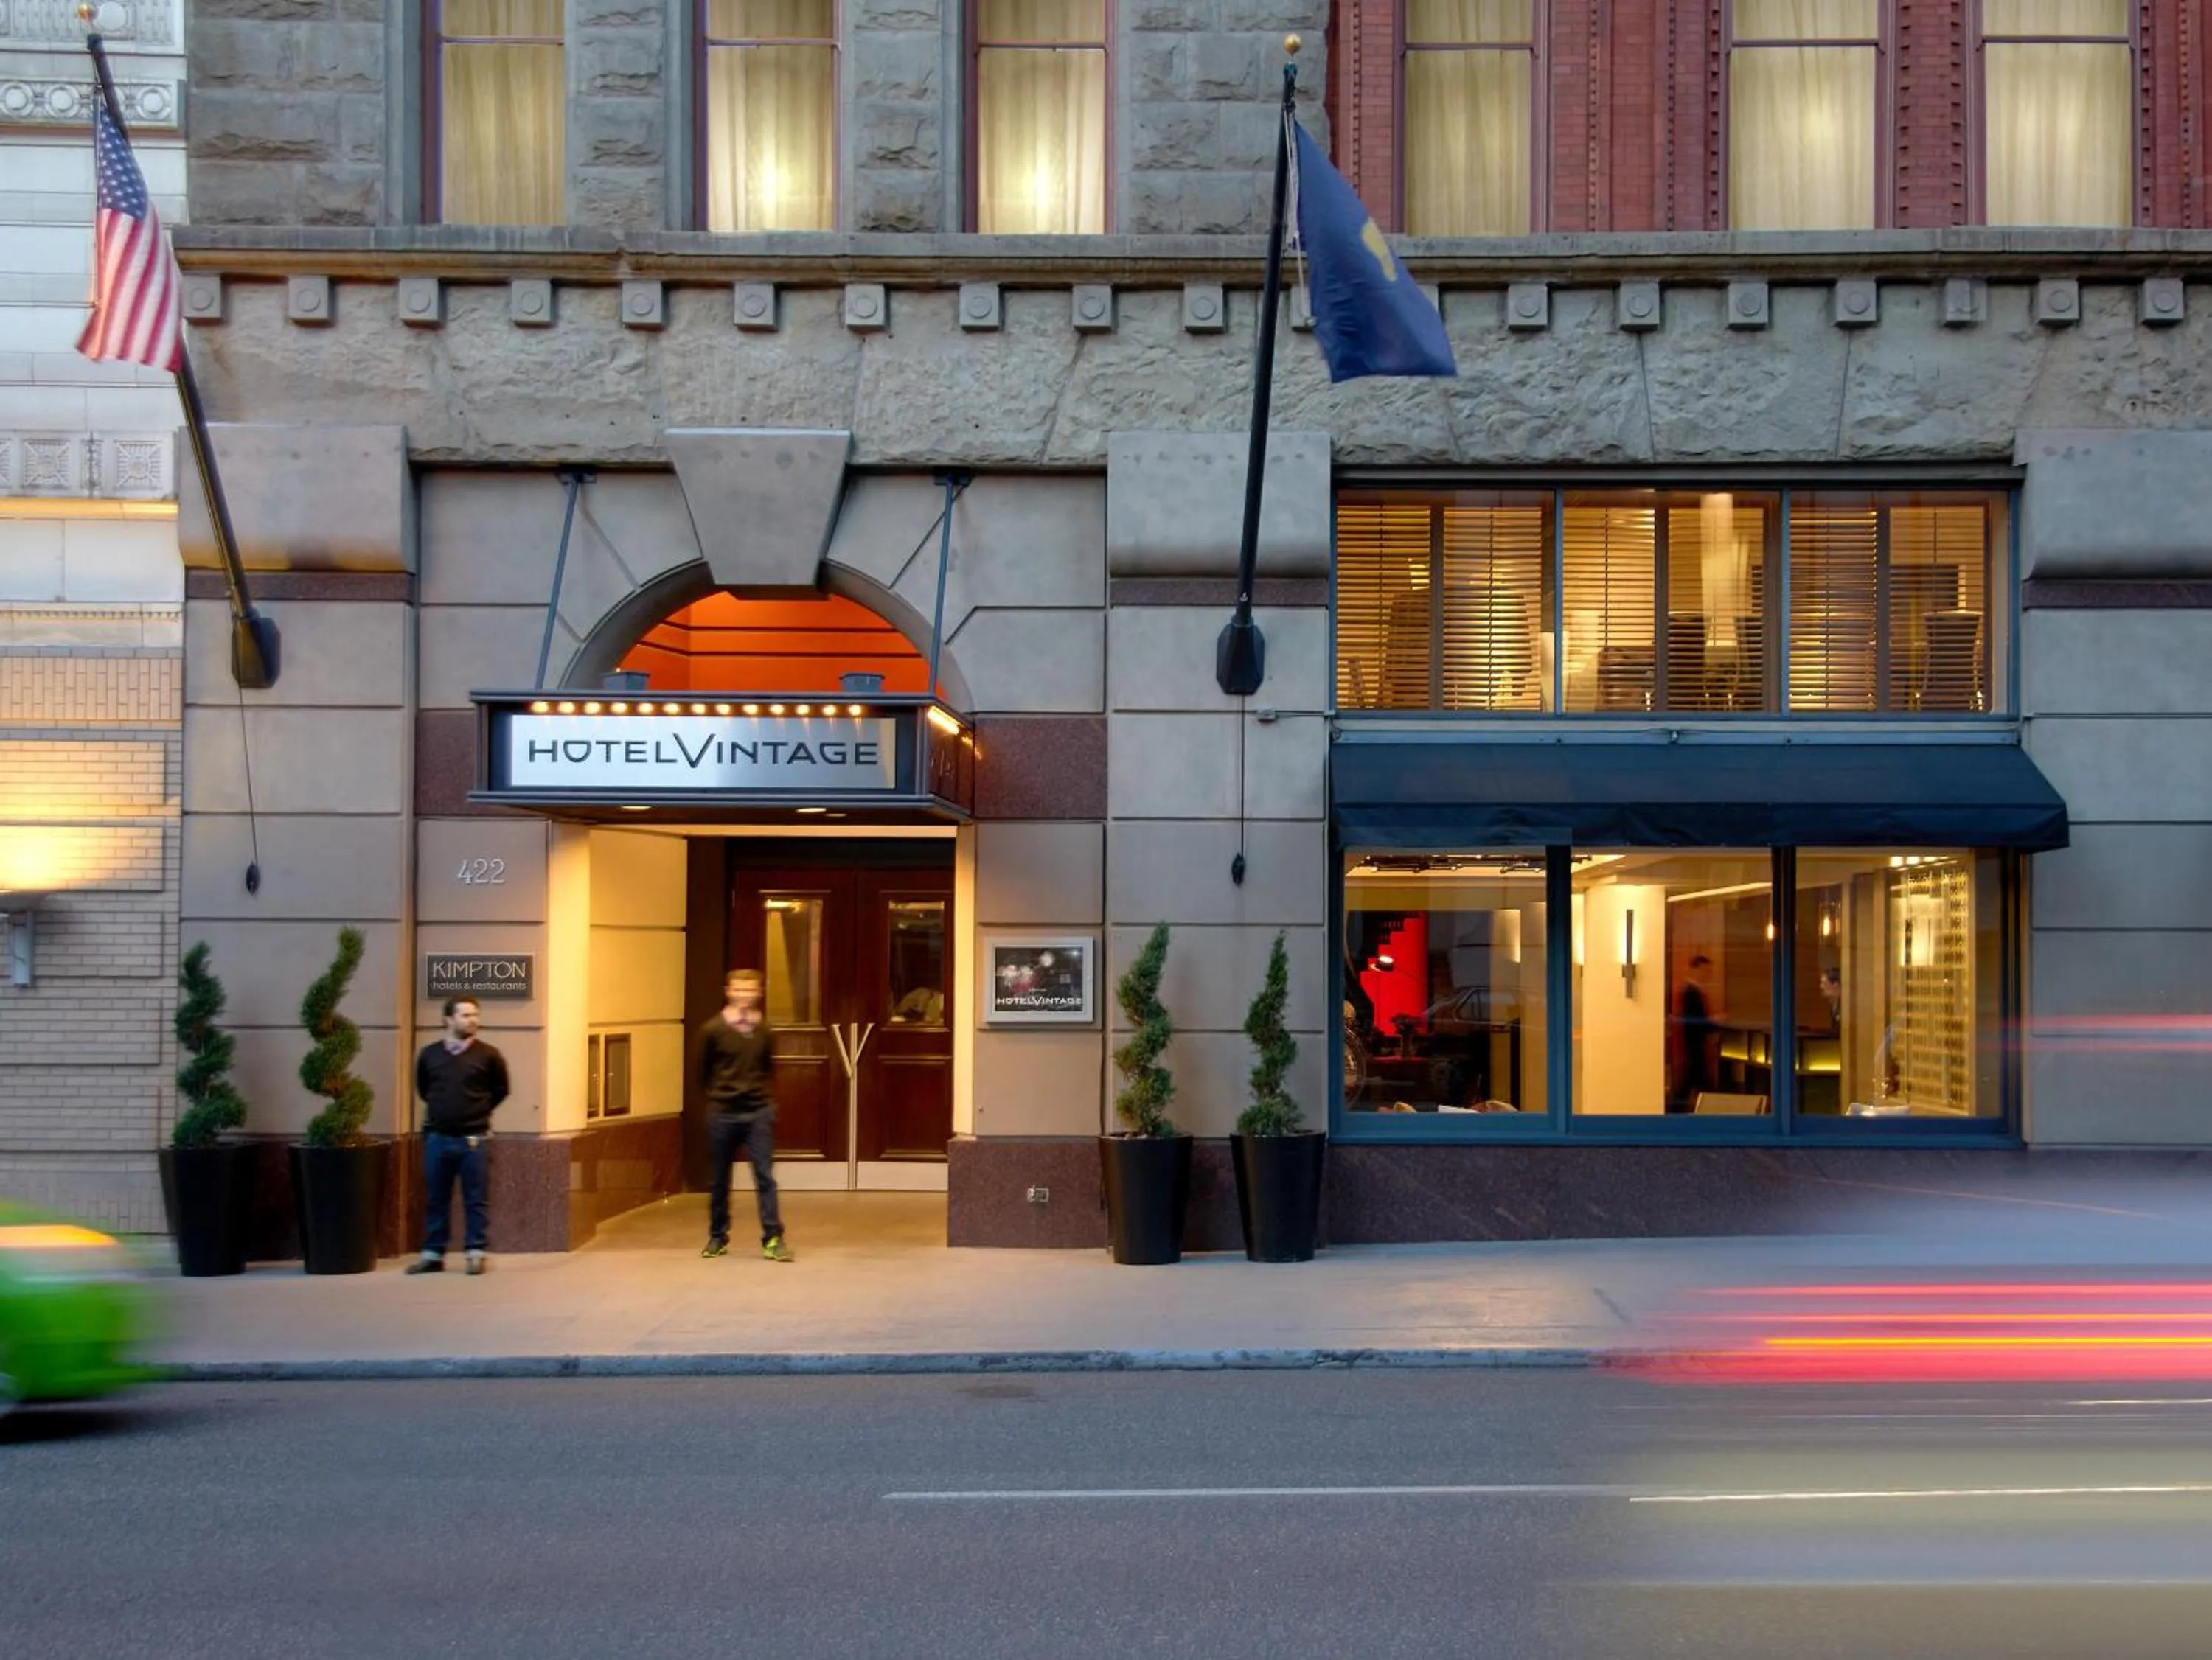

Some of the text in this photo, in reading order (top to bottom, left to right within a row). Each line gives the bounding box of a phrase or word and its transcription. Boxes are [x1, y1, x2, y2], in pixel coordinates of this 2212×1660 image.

[456, 858, 506, 884] 422
[432, 960, 526, 979] KIMPTON
[432, 981, 462, 990] hotels
[473, 981, 527, 990] restaurants
